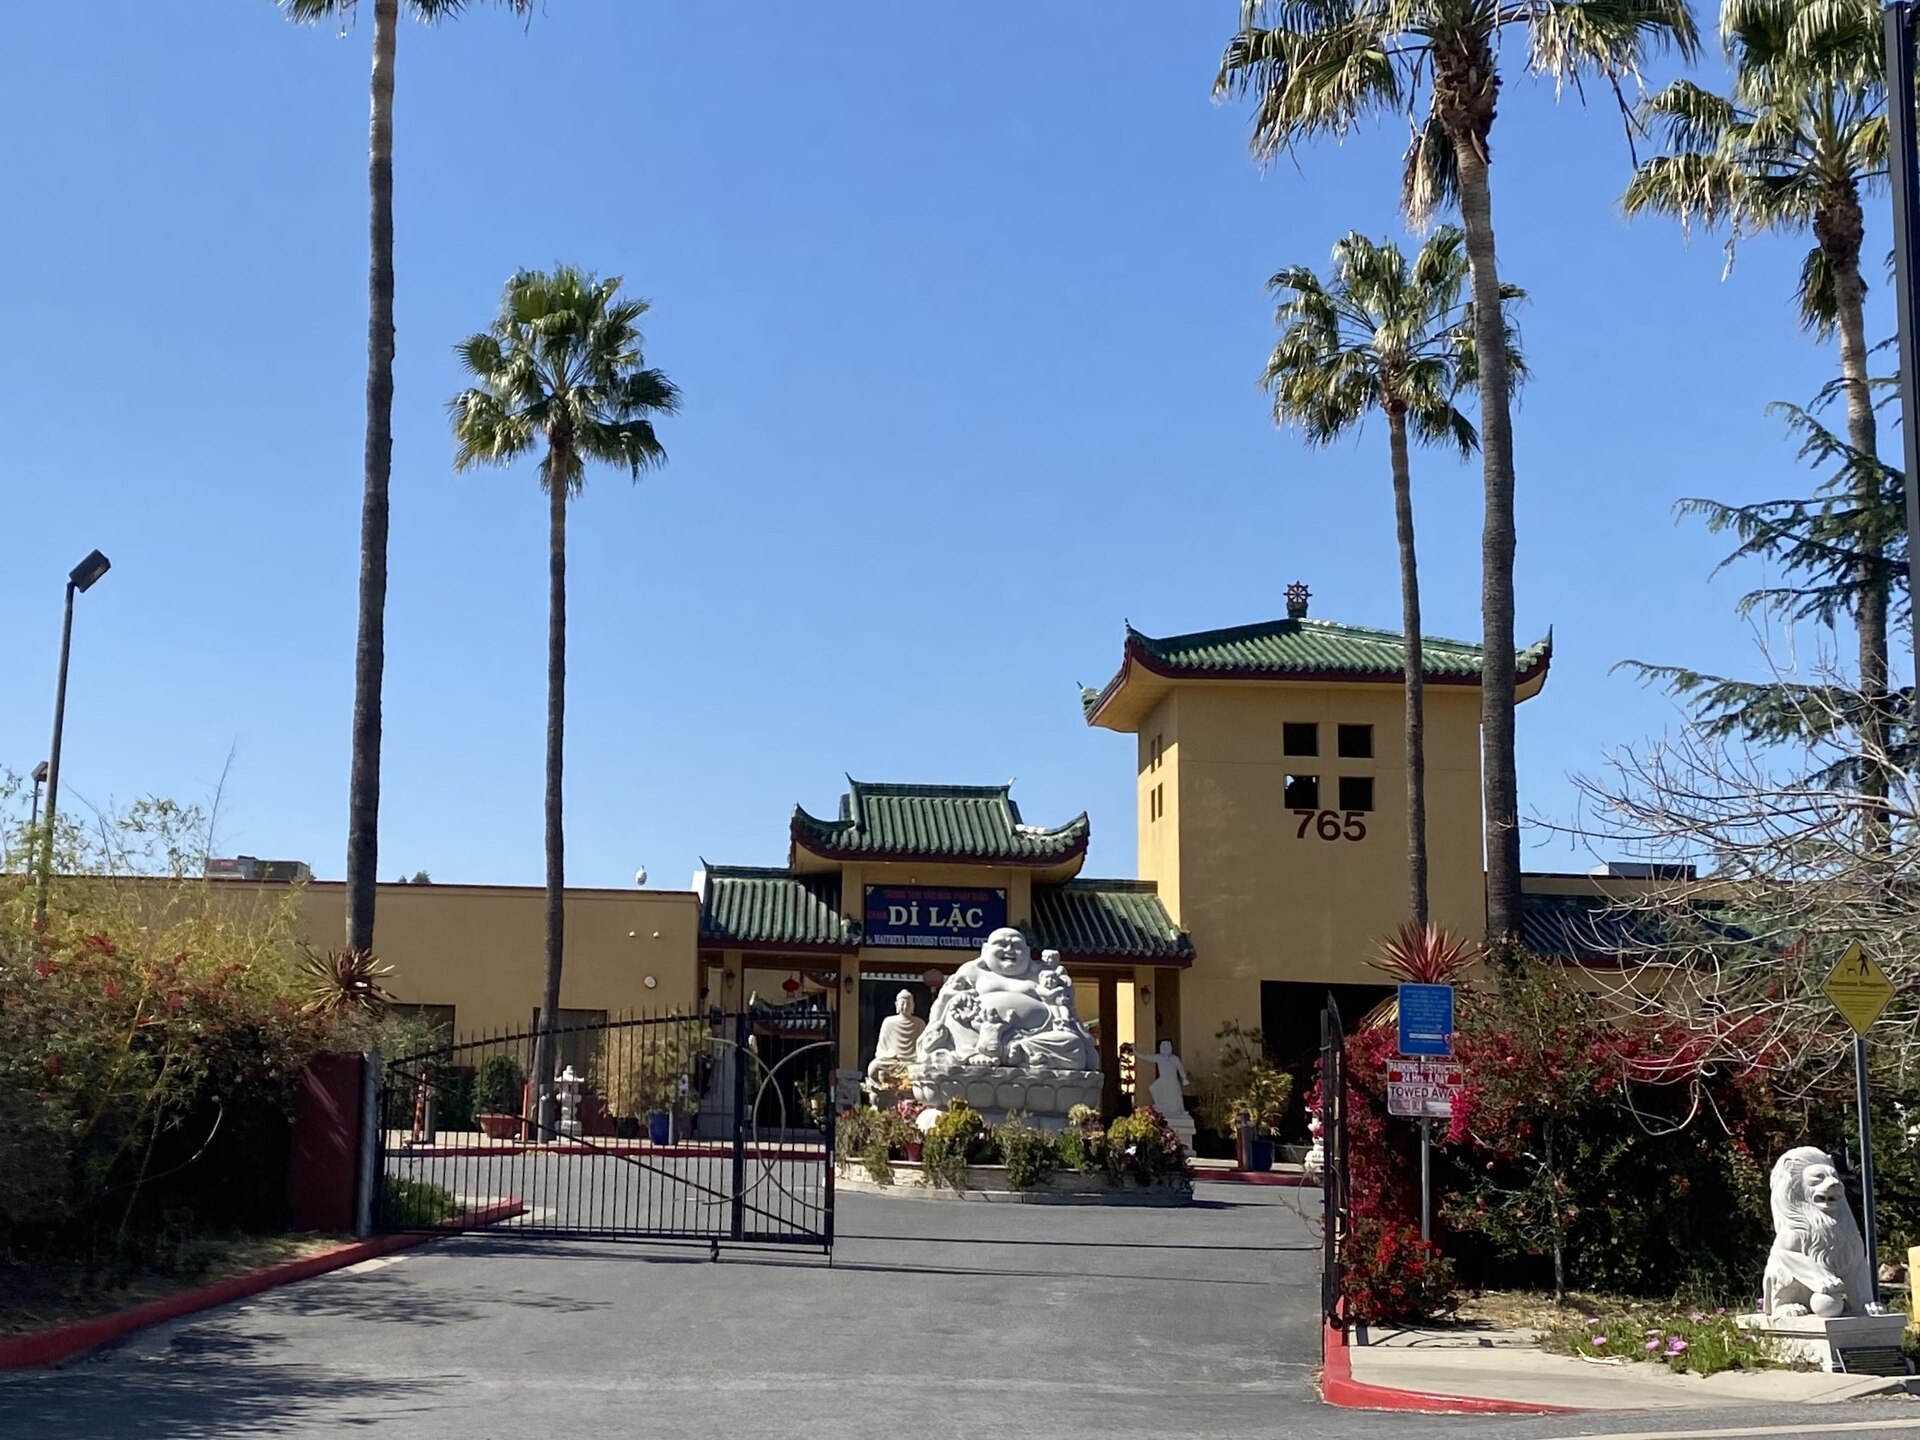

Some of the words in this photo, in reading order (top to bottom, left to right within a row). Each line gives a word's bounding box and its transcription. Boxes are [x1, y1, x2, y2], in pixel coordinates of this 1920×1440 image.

[1293, 810, 1366, 841] 765
[929, 903, 984, 932] LẶC
[939, 936, 971, 948] CULTURAL
[1390, 1086, 1428, 1098] TOWED
